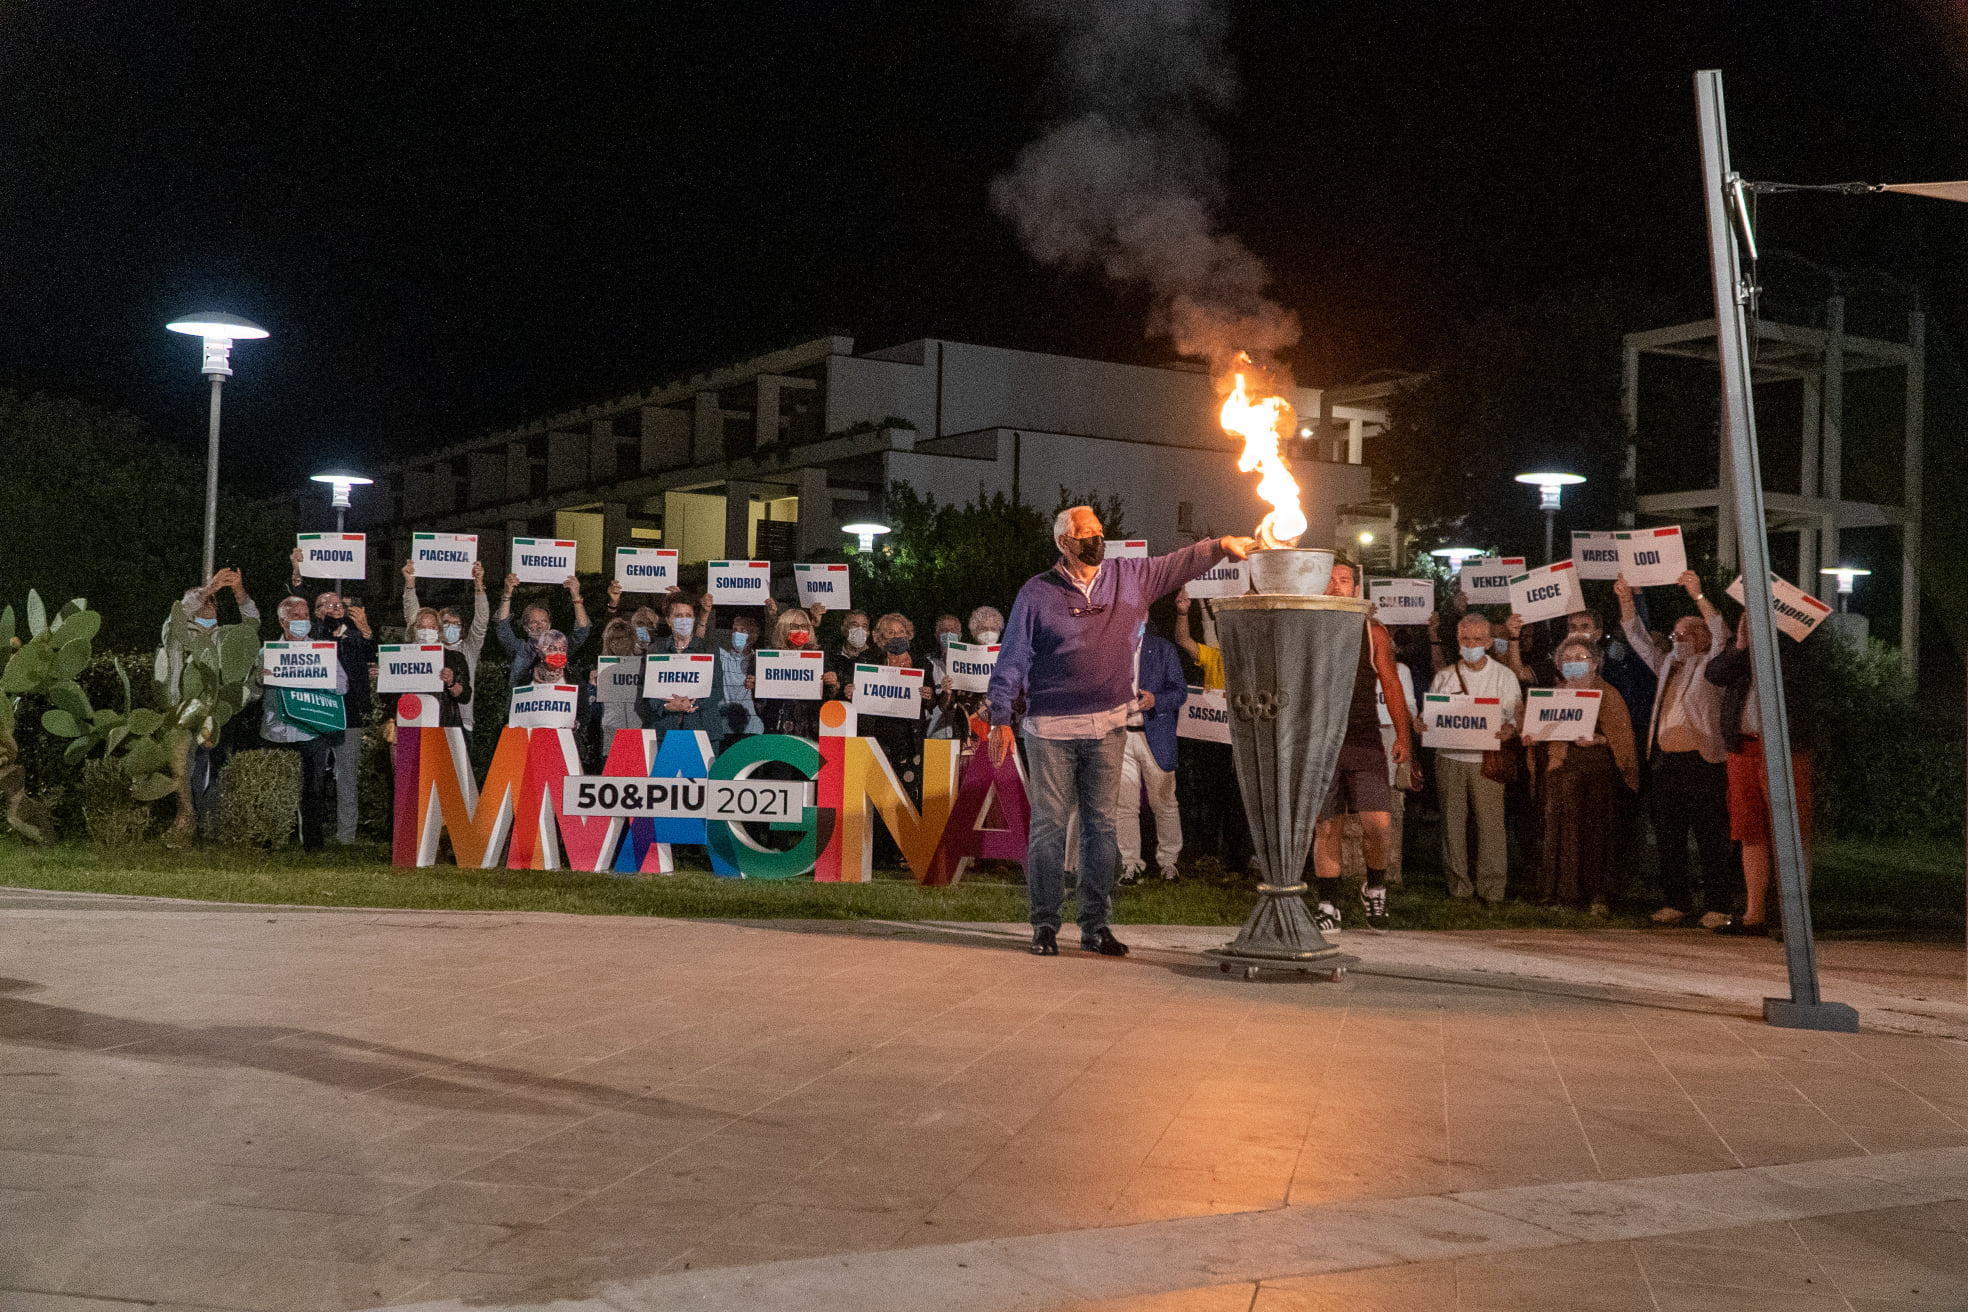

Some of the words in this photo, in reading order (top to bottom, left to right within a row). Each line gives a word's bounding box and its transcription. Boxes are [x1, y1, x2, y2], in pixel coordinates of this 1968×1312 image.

[309, 549, 353, 562] PADOVA
[419, 549, 469, 563] PIACENZA
[521, 554, 567, 568] VERCELLI
[1633, 550, 1661, 566] LODI
[626, 564, 667, 577] GENOVA
[716, 576, 762, 589] SONDRIO
[806, 581, 834, 594] ROMA
[1471, 575, 1511, 588] VENEZI
[1526, 583, 1562, 603] LECCE
[1379, 595, 1425, 608] SALERNO
[280, 653, 321, 666] MASSA
[273, 666, 328, 679] CARRARA
[389, 662, 433, 675] VICENZA
[765, 668, 814, 682] BRINDISI
[657, 671, 700, 684] FIRENZE
[863, 683, 911, 700] L'AQUILA
[514, 699, 571, 714] MACERATA
[1539, 708, 1583, 722] MILANO
[1435, 714, 1488, 730] ANCONA
[577, 778, 705, 812] 50&PIÙ
[717, 787, 789, 816] 2021
